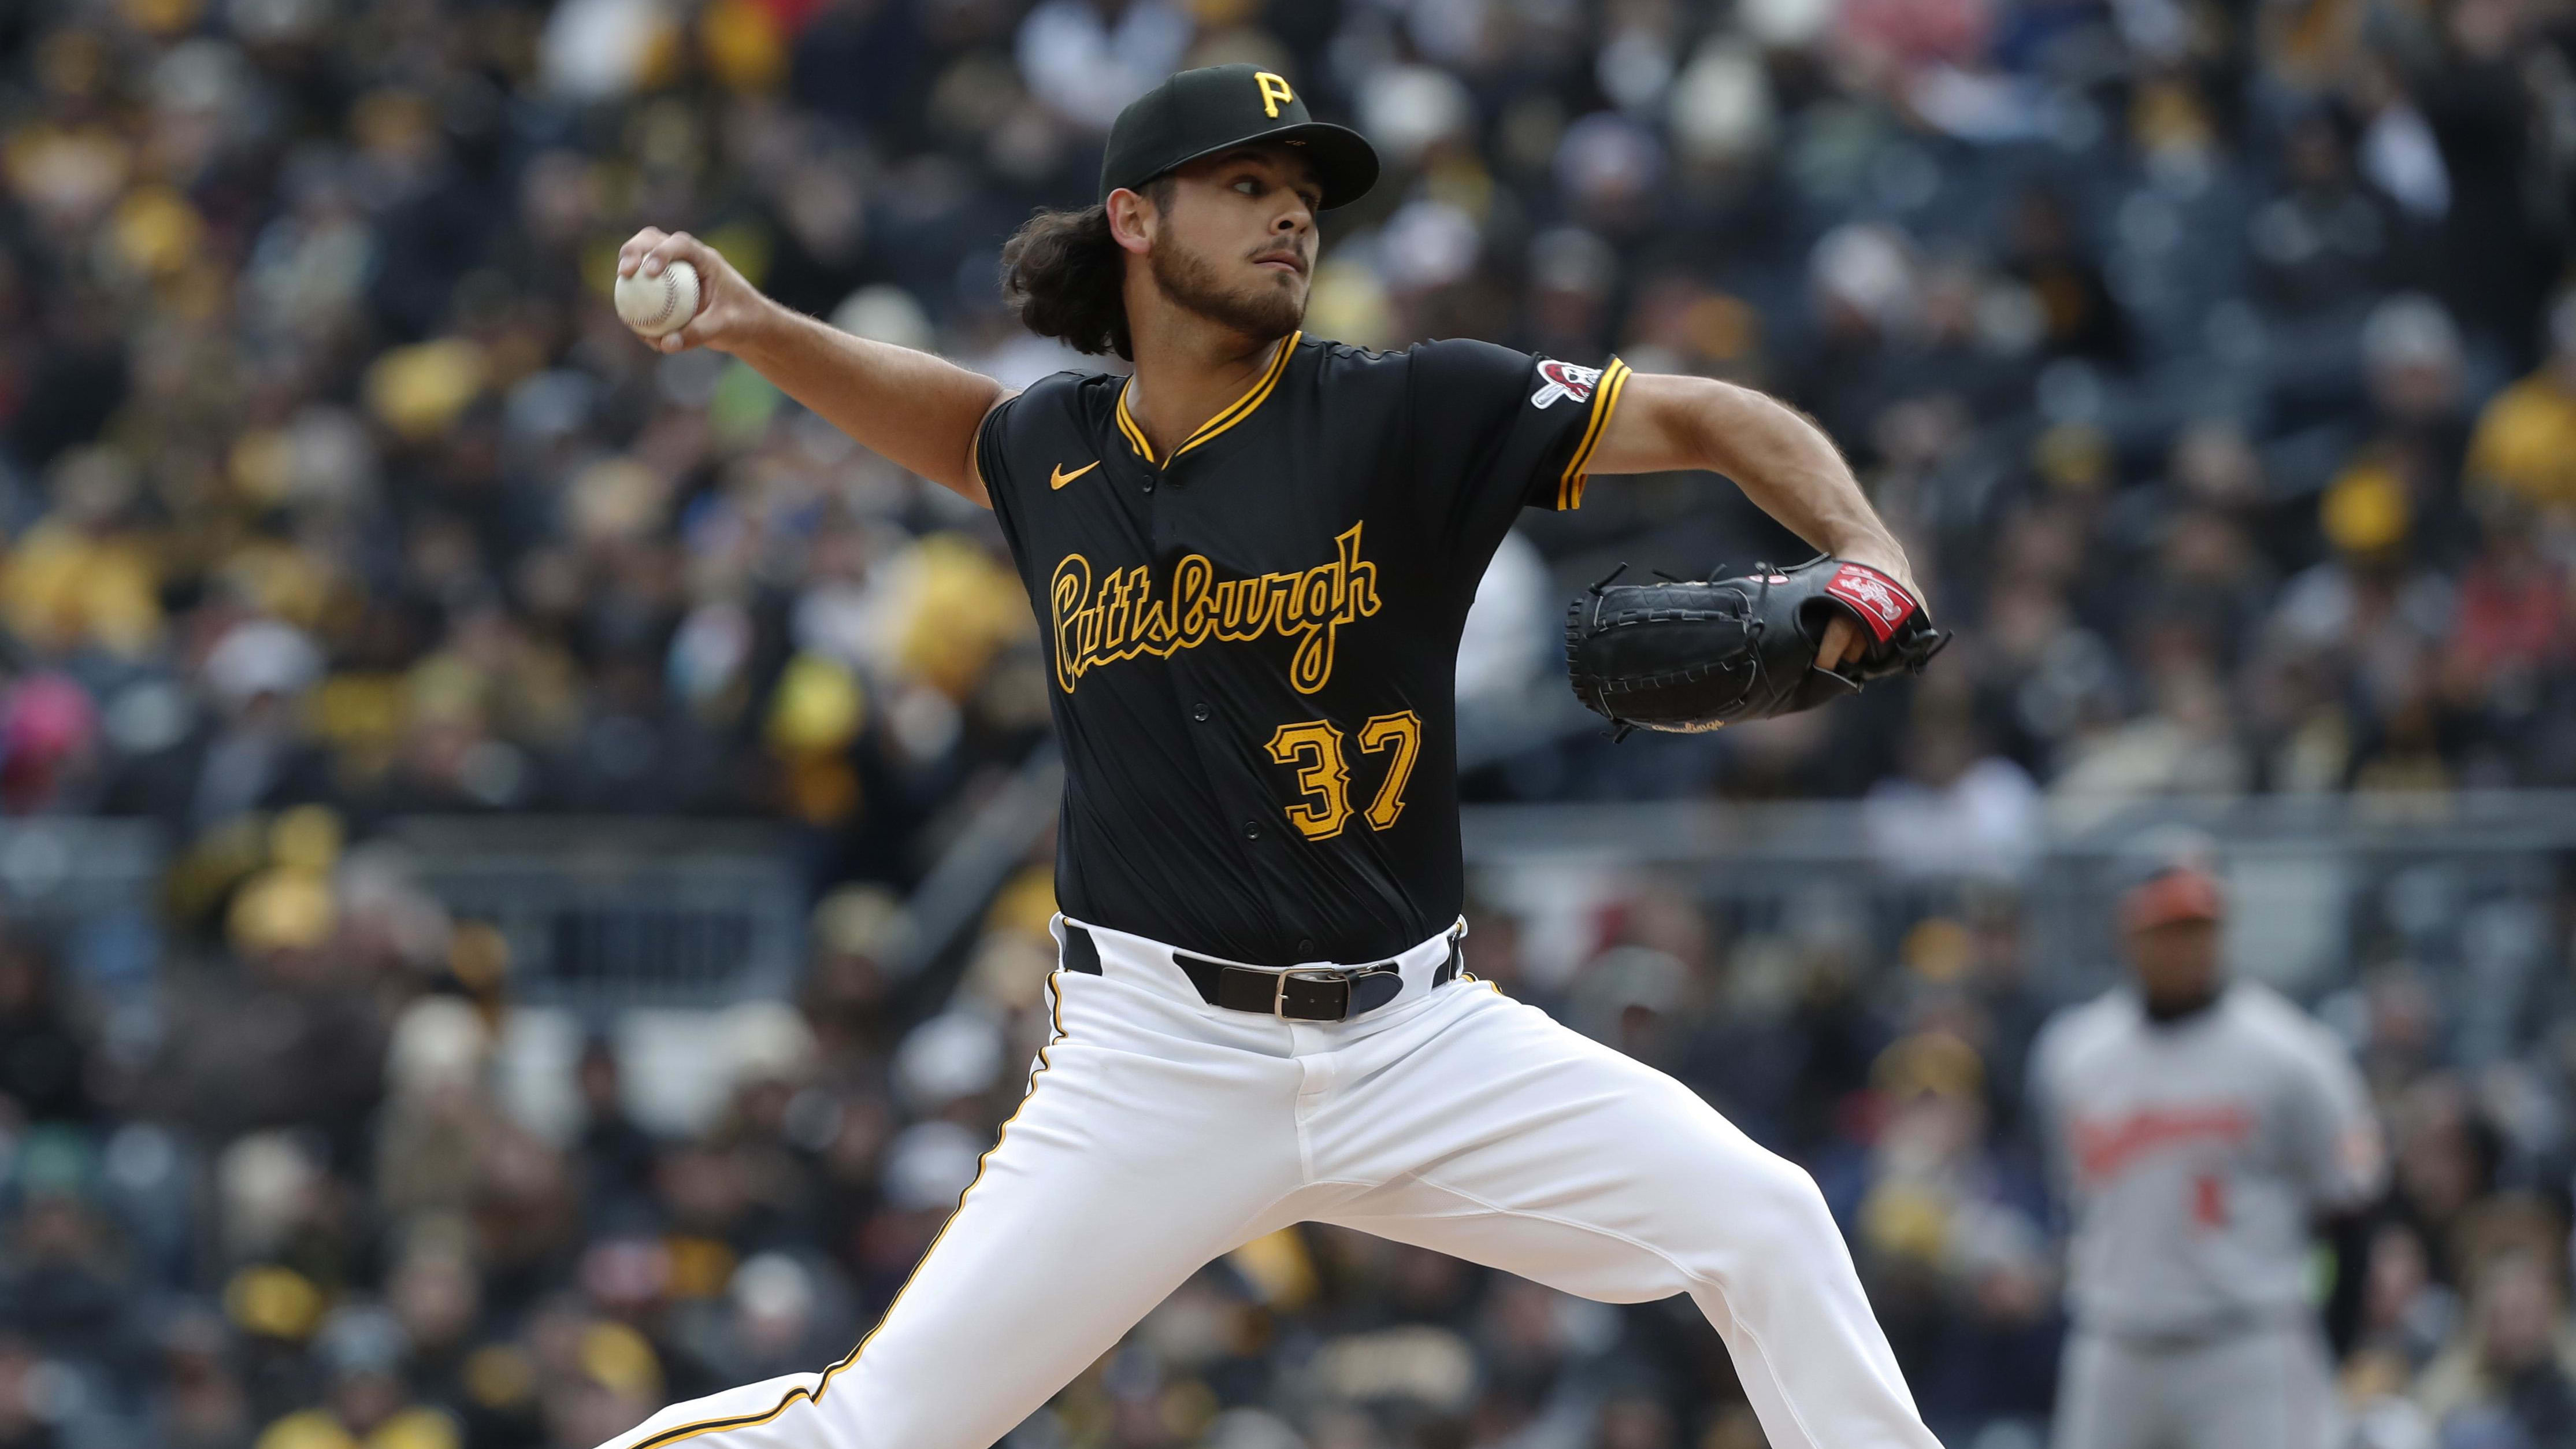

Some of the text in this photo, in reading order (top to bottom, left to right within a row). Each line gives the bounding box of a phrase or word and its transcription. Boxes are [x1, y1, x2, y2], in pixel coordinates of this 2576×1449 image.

[1254, 72, 1293, 118] P
[1051, 520, 1382, 694] Pittsburgh
[1263, 710, 1421, 841] 37
